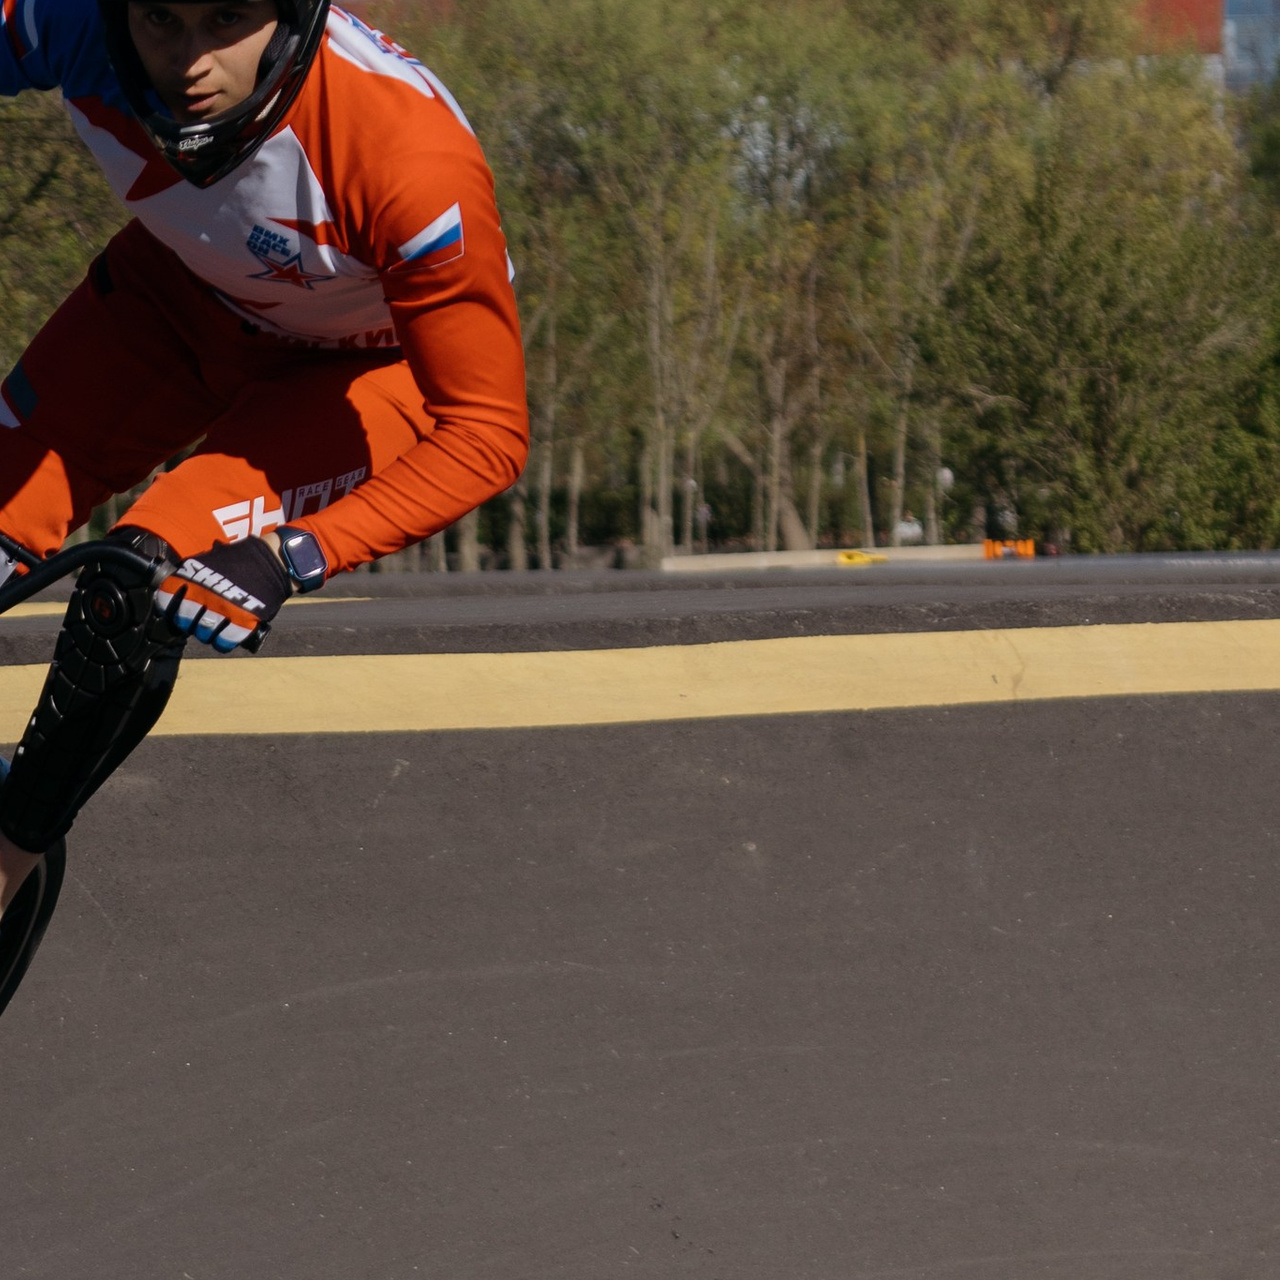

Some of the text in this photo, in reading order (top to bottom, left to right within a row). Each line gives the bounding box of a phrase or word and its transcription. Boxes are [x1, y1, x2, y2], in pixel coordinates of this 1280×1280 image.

[248, 231, 292, 257] RACE
[252, 224, 290, 246] BMX
[298, 469, 366, 499] RACE GEAR
[176, 558, 266, 612] SHIFT
